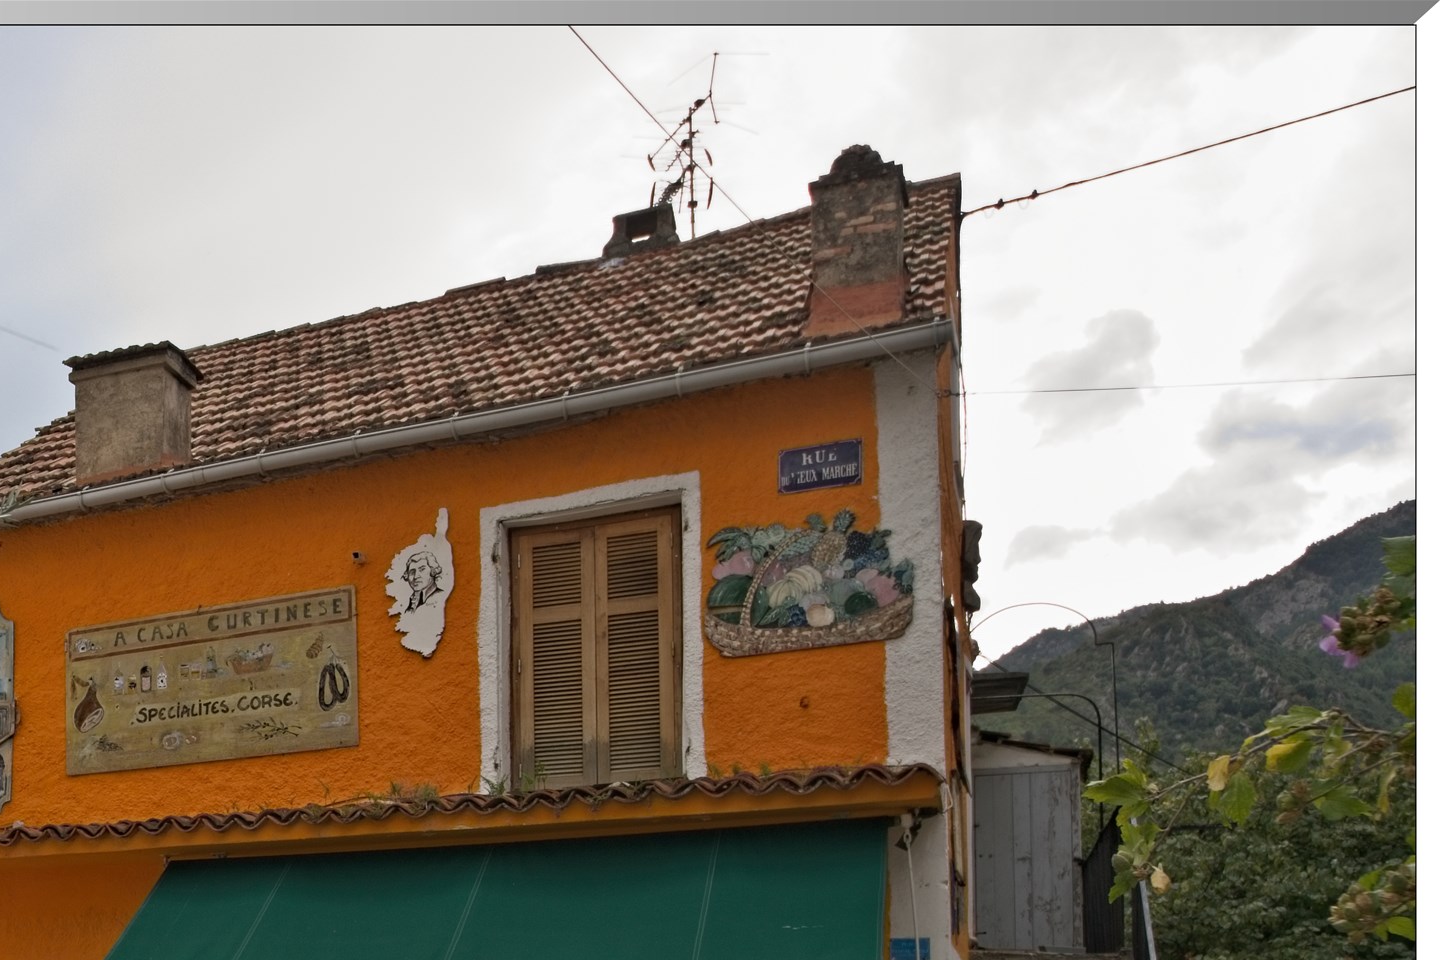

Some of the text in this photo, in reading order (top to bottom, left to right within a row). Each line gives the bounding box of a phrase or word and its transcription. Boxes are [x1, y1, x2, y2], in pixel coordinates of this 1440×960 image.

[113, 597, 343, 647] A CASA CURTINESE
